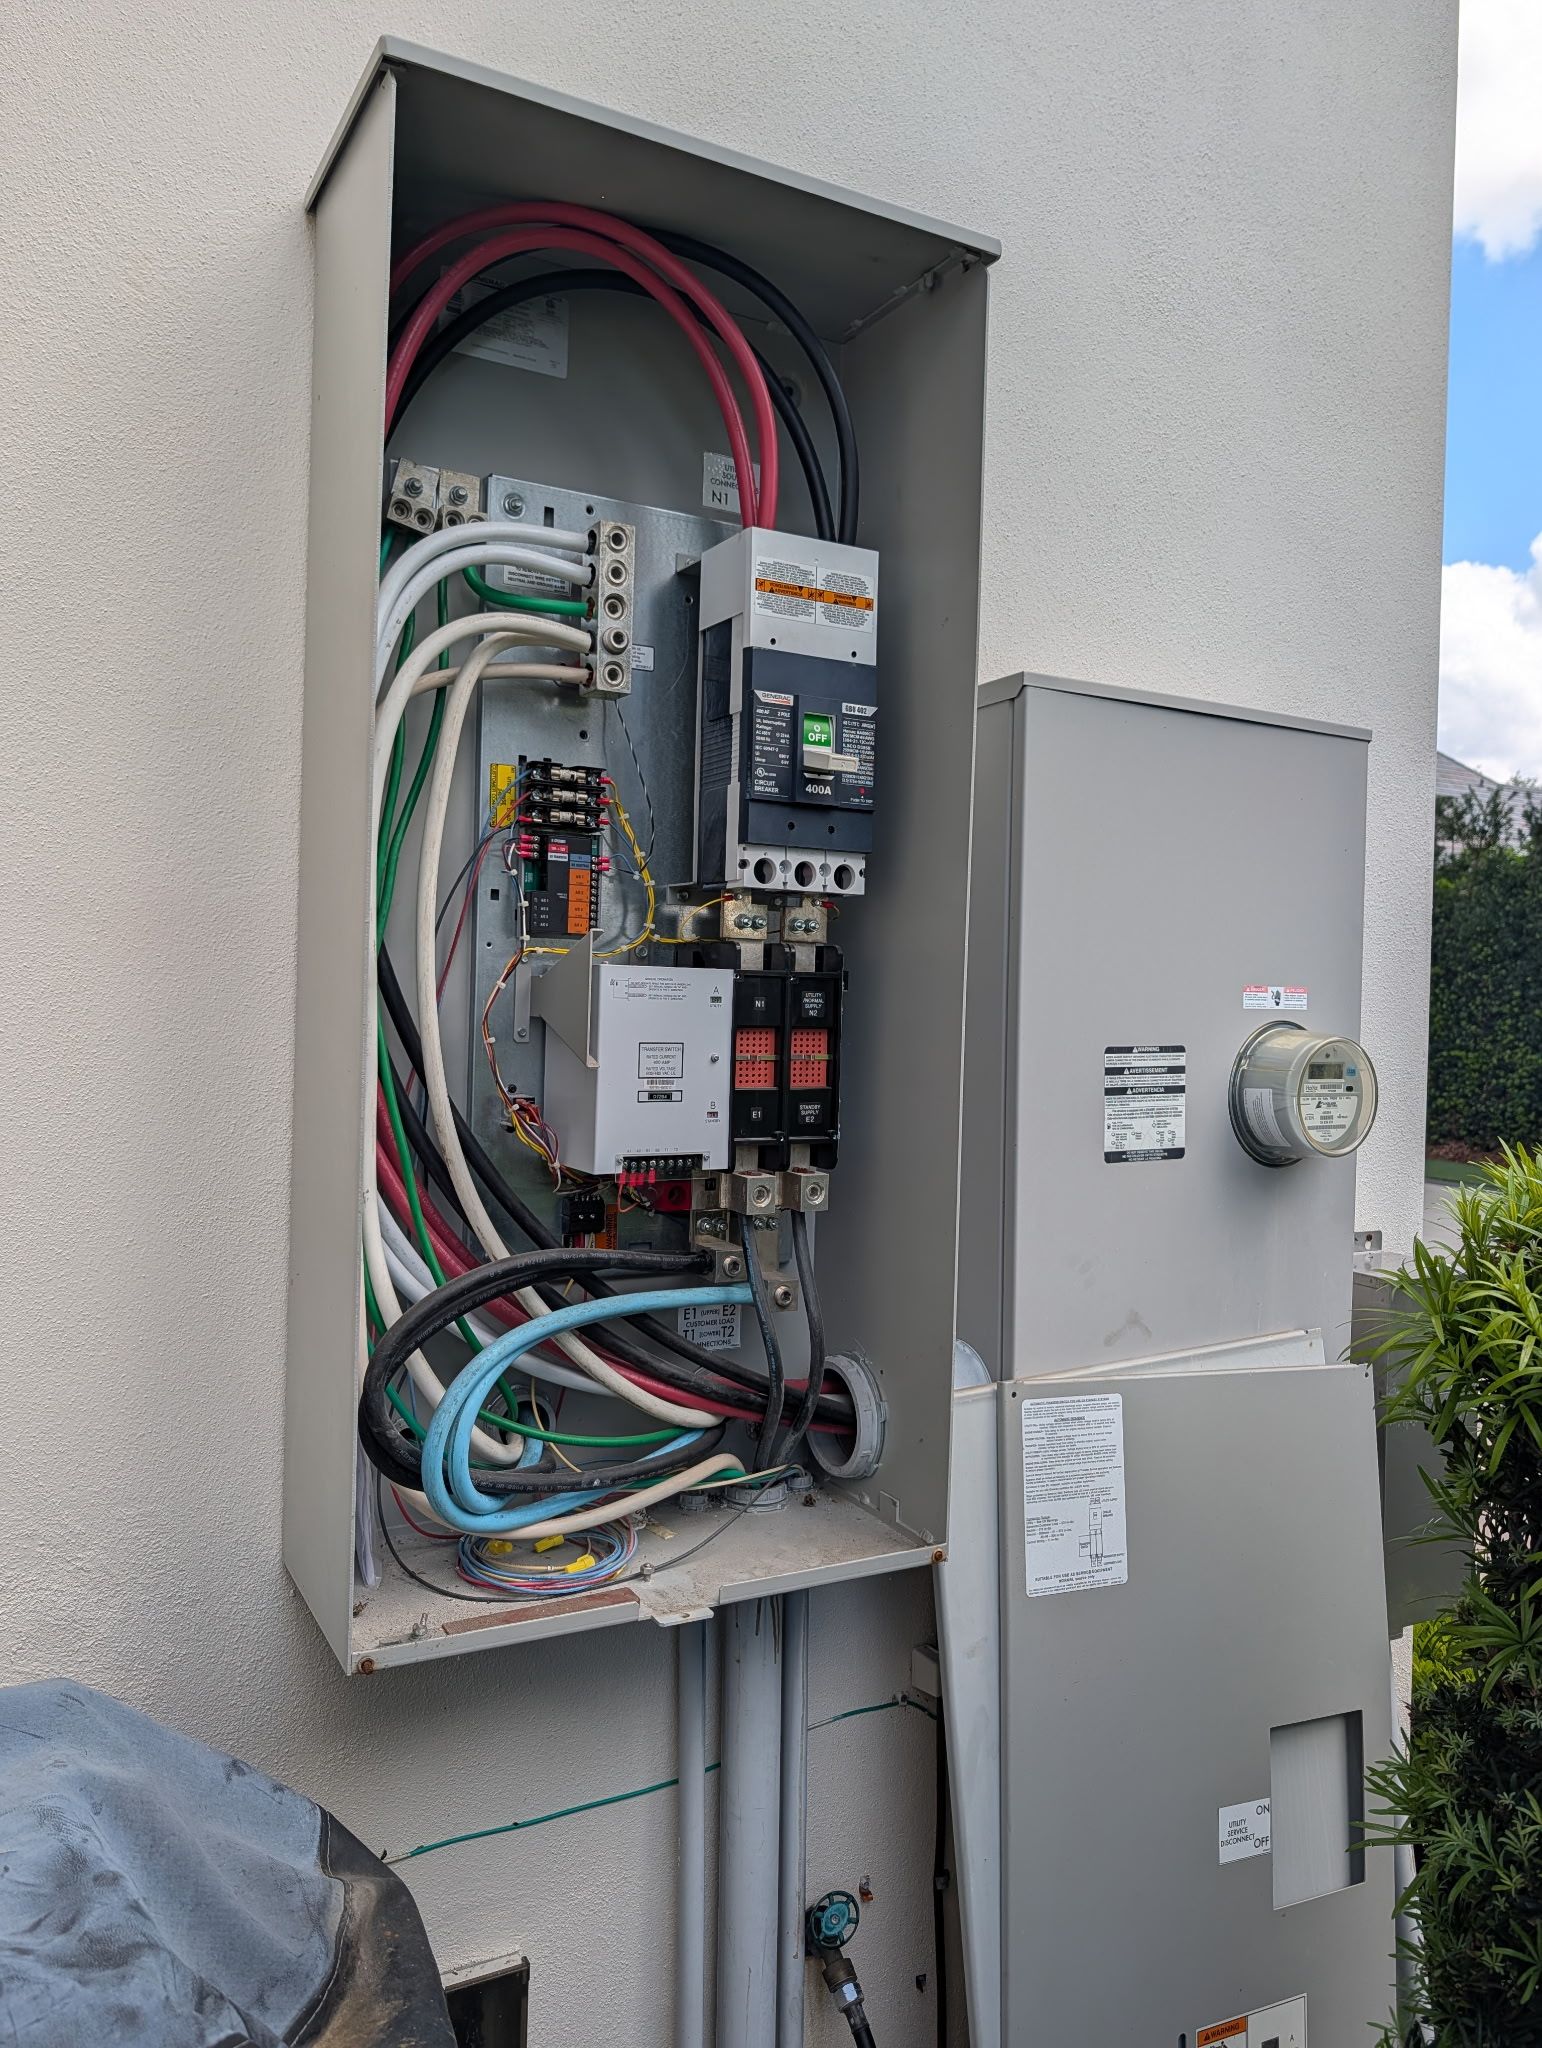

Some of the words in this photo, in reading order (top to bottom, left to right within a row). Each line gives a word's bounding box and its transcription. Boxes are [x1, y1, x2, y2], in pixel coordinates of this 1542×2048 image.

[711, 490, 729, 506] N1
[761, 692, 791, 701] GENERAC
[808, 732, 828, 743] OFF
[754, 779, 776, 787] CIRCUIT
[754, 785, 779, 793] BREAKER
[805, 784, 832, 796] 400A
[712, 986, 720, 995] A
[755, 1000, 765, 1008] N1
[808, 1009, 818, 1017] N2
[752, 1110, 761, 1119] E1
[684, 1307, 697, 1320] E1
[722, 1304, 736, 1317] E2
[685, 1320, 718, 1328] CUSTOMER
[718, 1317, 735, 1325] LOAD
[683, 1329, 695, 1341] T1
[721, 1325, 735, 1338] T2
[1255, 1803, 1270, 1816] ON
[1228, 1818, 1247, 1829] UTILITY
[1227, 1826, 1248, 1838] SERVICE
[1220, 1833, 1255, 1848] DISCONNECT
[1253, 1835, 1270, 1849] OFF
[1210, 2022, 1240, 2039] WARNING
